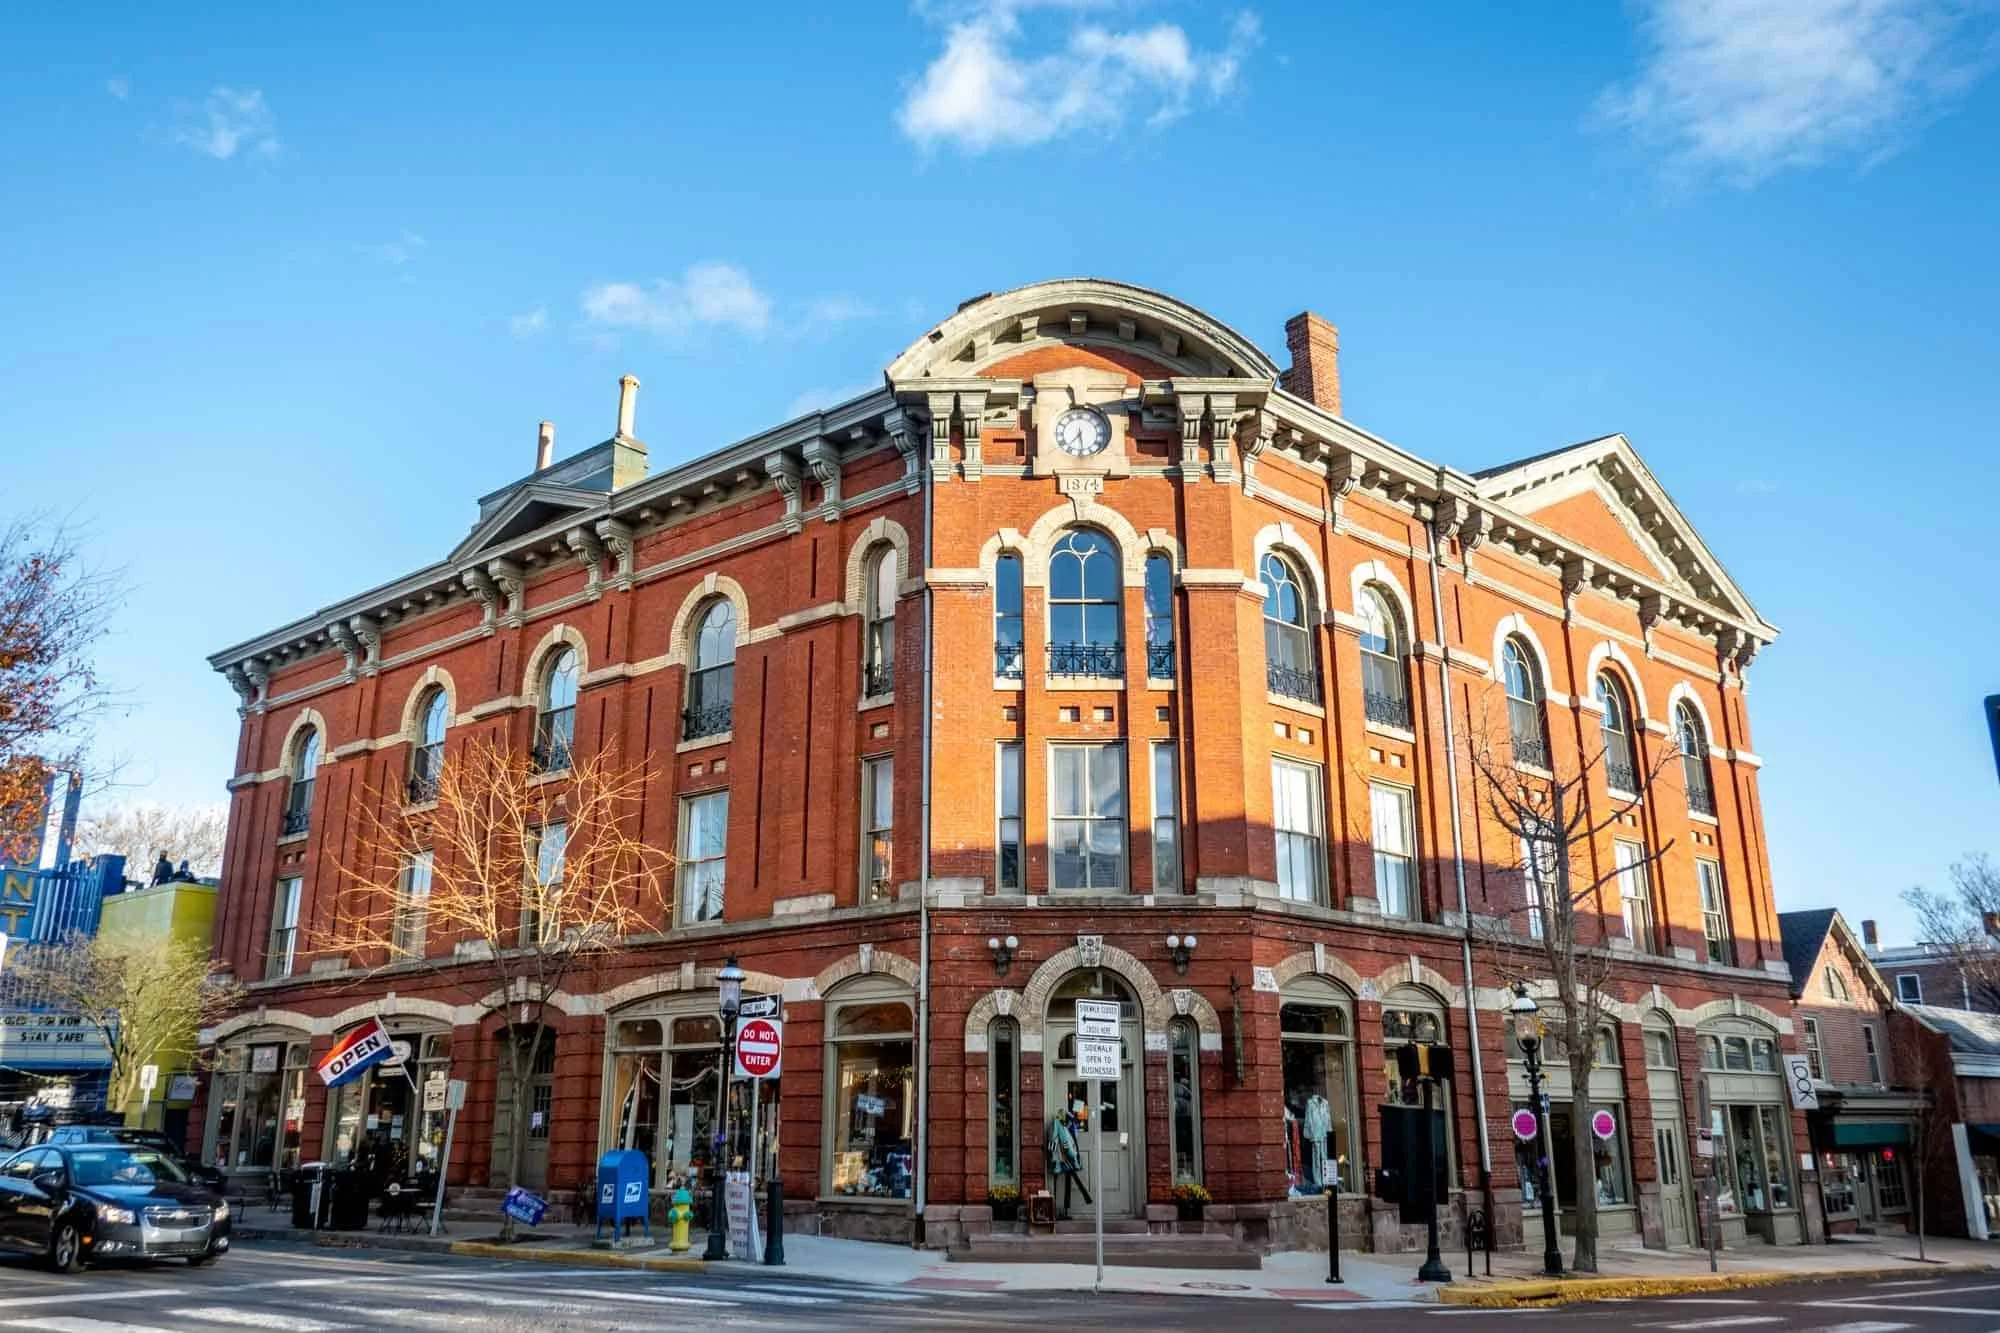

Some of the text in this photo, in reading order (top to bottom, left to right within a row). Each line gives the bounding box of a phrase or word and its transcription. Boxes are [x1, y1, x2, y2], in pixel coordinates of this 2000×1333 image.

[1066, 479, 1099, 491] 1874
[21, 1031, 50, 1042] STAY
[744, 1029, 775, 1041] DO NOT
[1084, 1044, 1113, 1053] SIDEWALK
[330, 1035, 380, 1075] OPEN
[745, 1055, 771, 1067] ENTER
[1086, 1055, 1112, 1065] OPEN TO
[1081, 1065, 1117, 1075] BUSINESSES
[1791, 1060, 1816, 1102] LOOK
